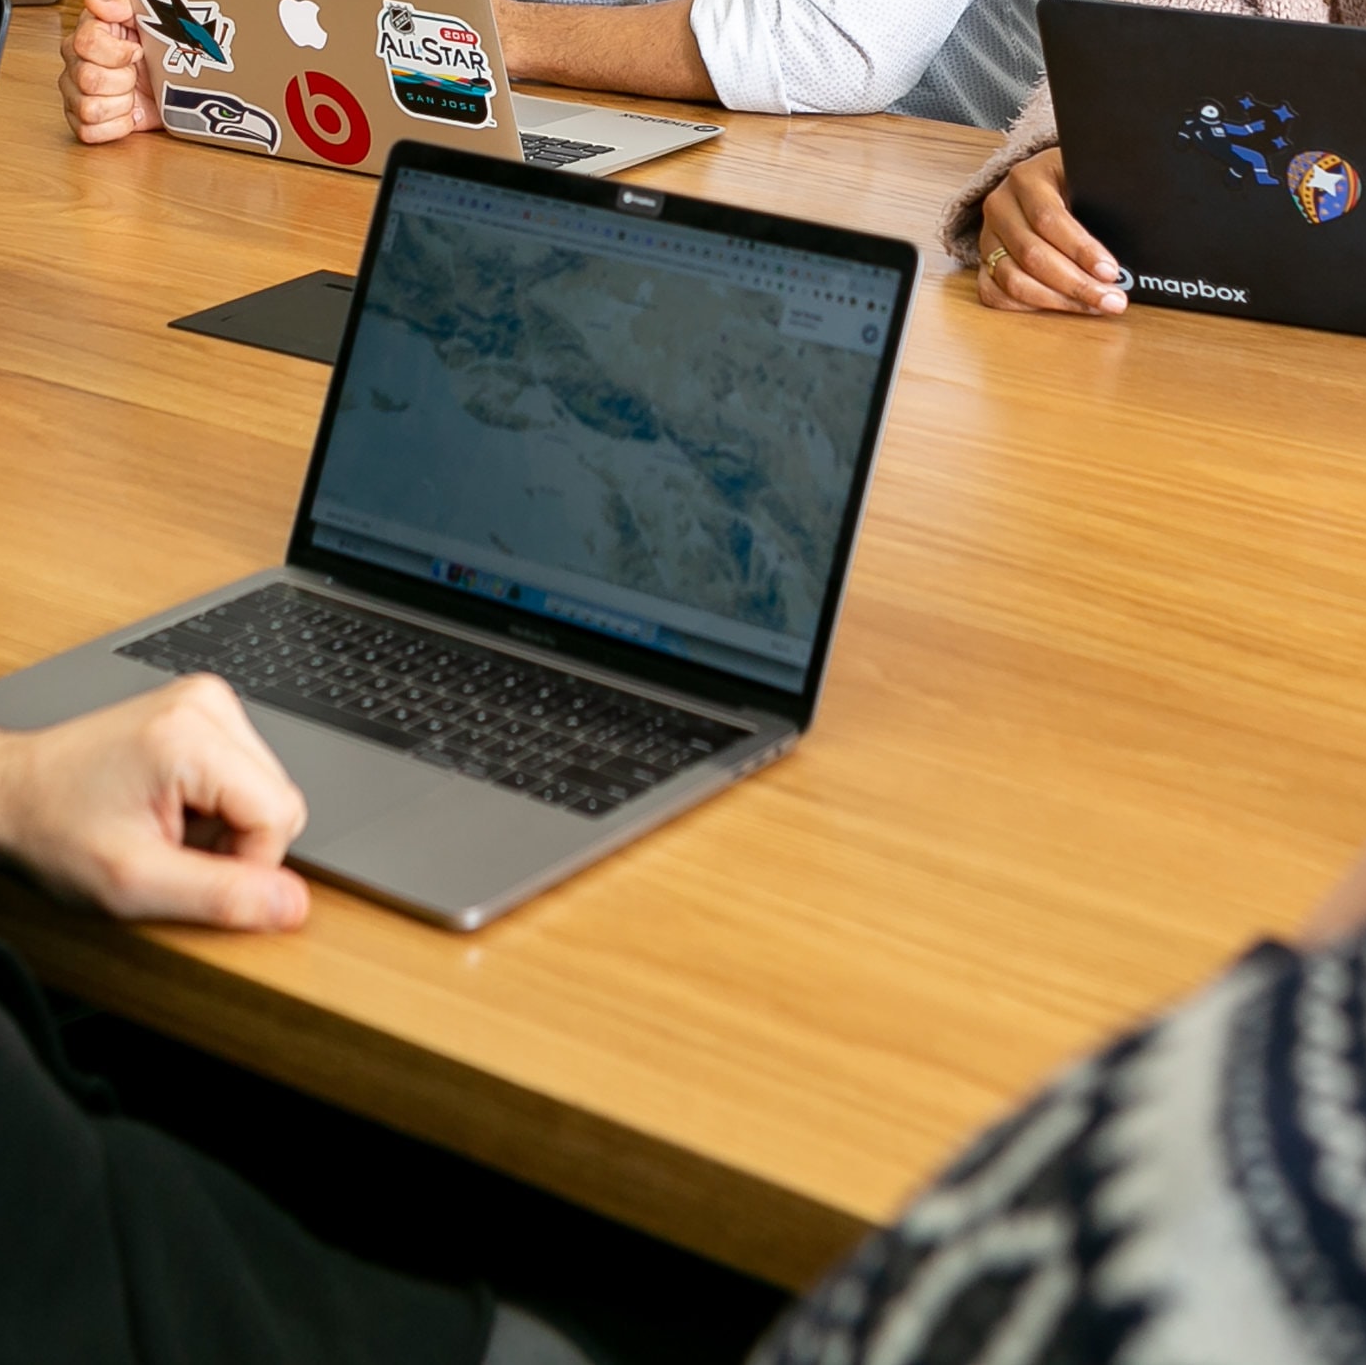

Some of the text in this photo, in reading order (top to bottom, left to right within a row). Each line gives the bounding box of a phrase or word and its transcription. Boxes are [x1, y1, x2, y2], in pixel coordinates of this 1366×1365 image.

[443, 30, 475, 43] 2019
[406, 92, 477, 112] SAN JOSE
[618, 113, 694, 128] mapbox
[1139, 271, 1248, 304] mapbox
